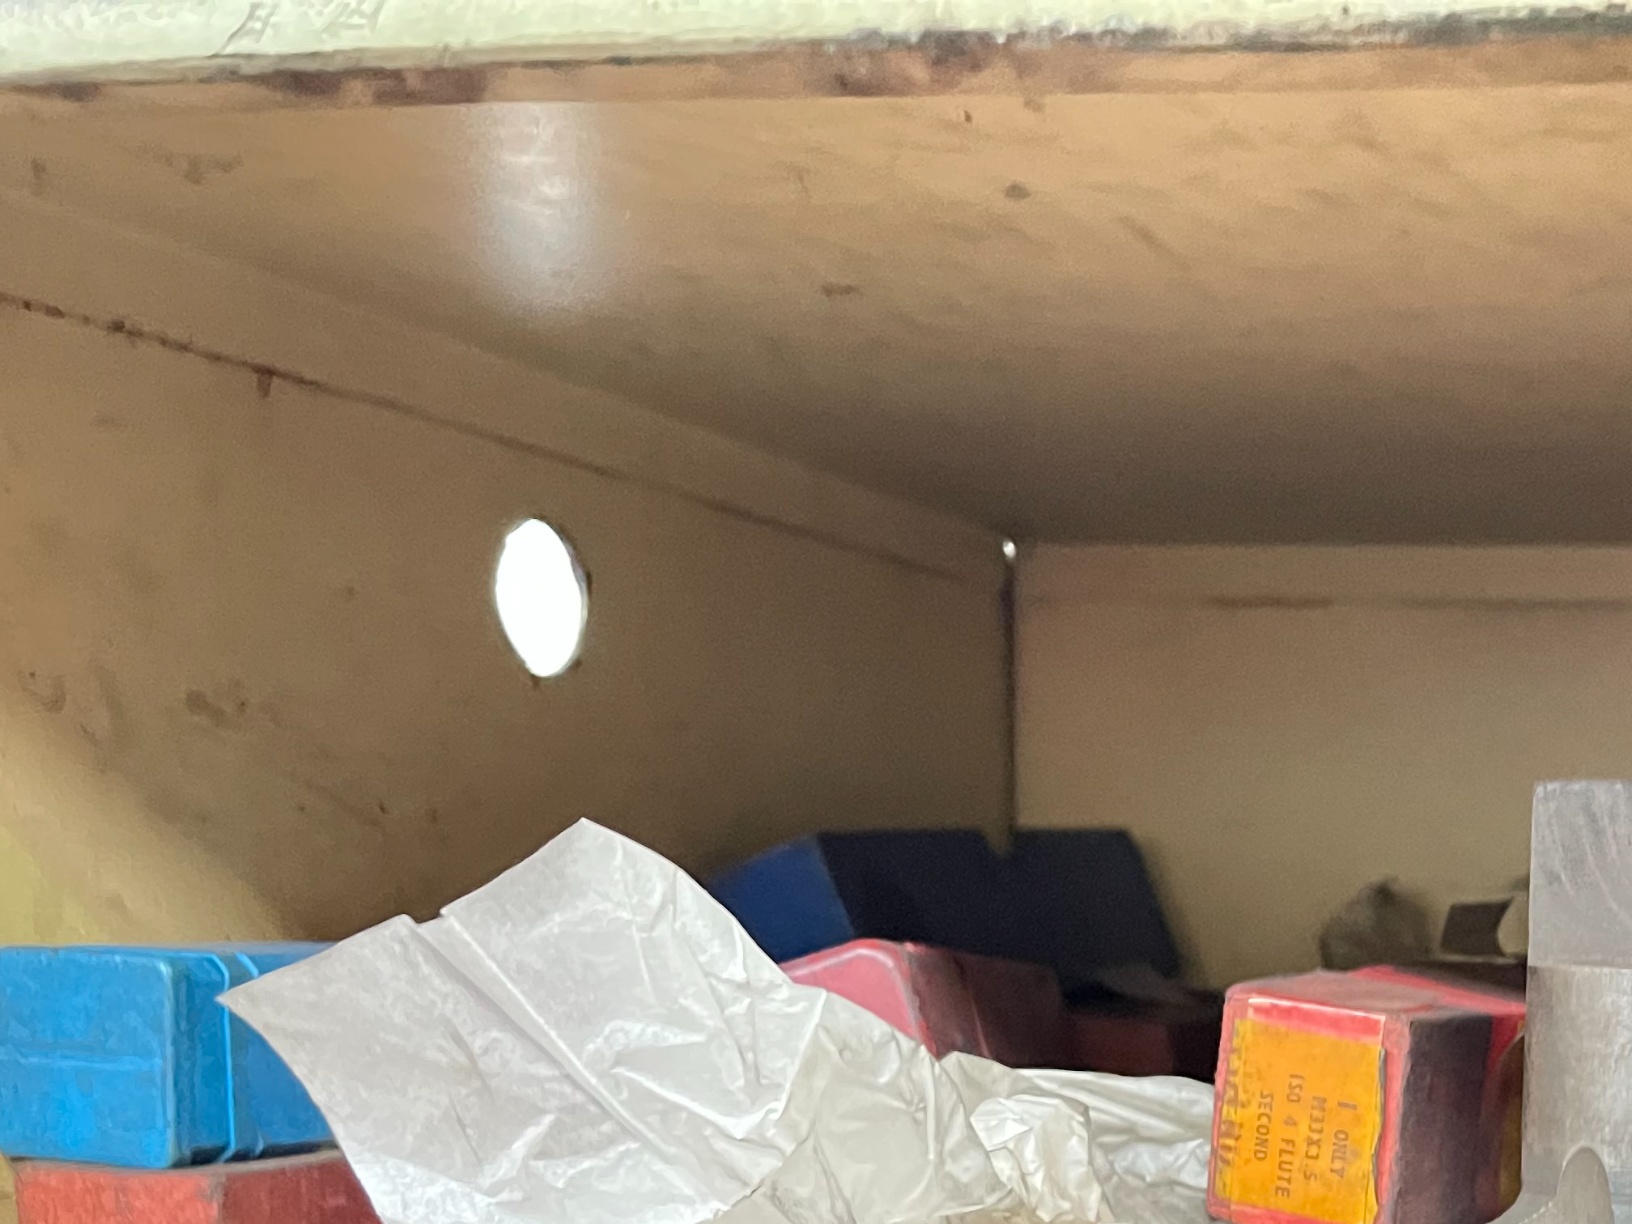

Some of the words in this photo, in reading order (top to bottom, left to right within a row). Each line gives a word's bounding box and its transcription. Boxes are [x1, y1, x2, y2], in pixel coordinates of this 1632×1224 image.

[1286, 1073, 1305, 1103] ISO
[1253, 1091, 1274, 1162] SECOND
[1330, 1129, 1350, 1179] ONLY
[1275, 1137, 1296, 1199] FLUTE
